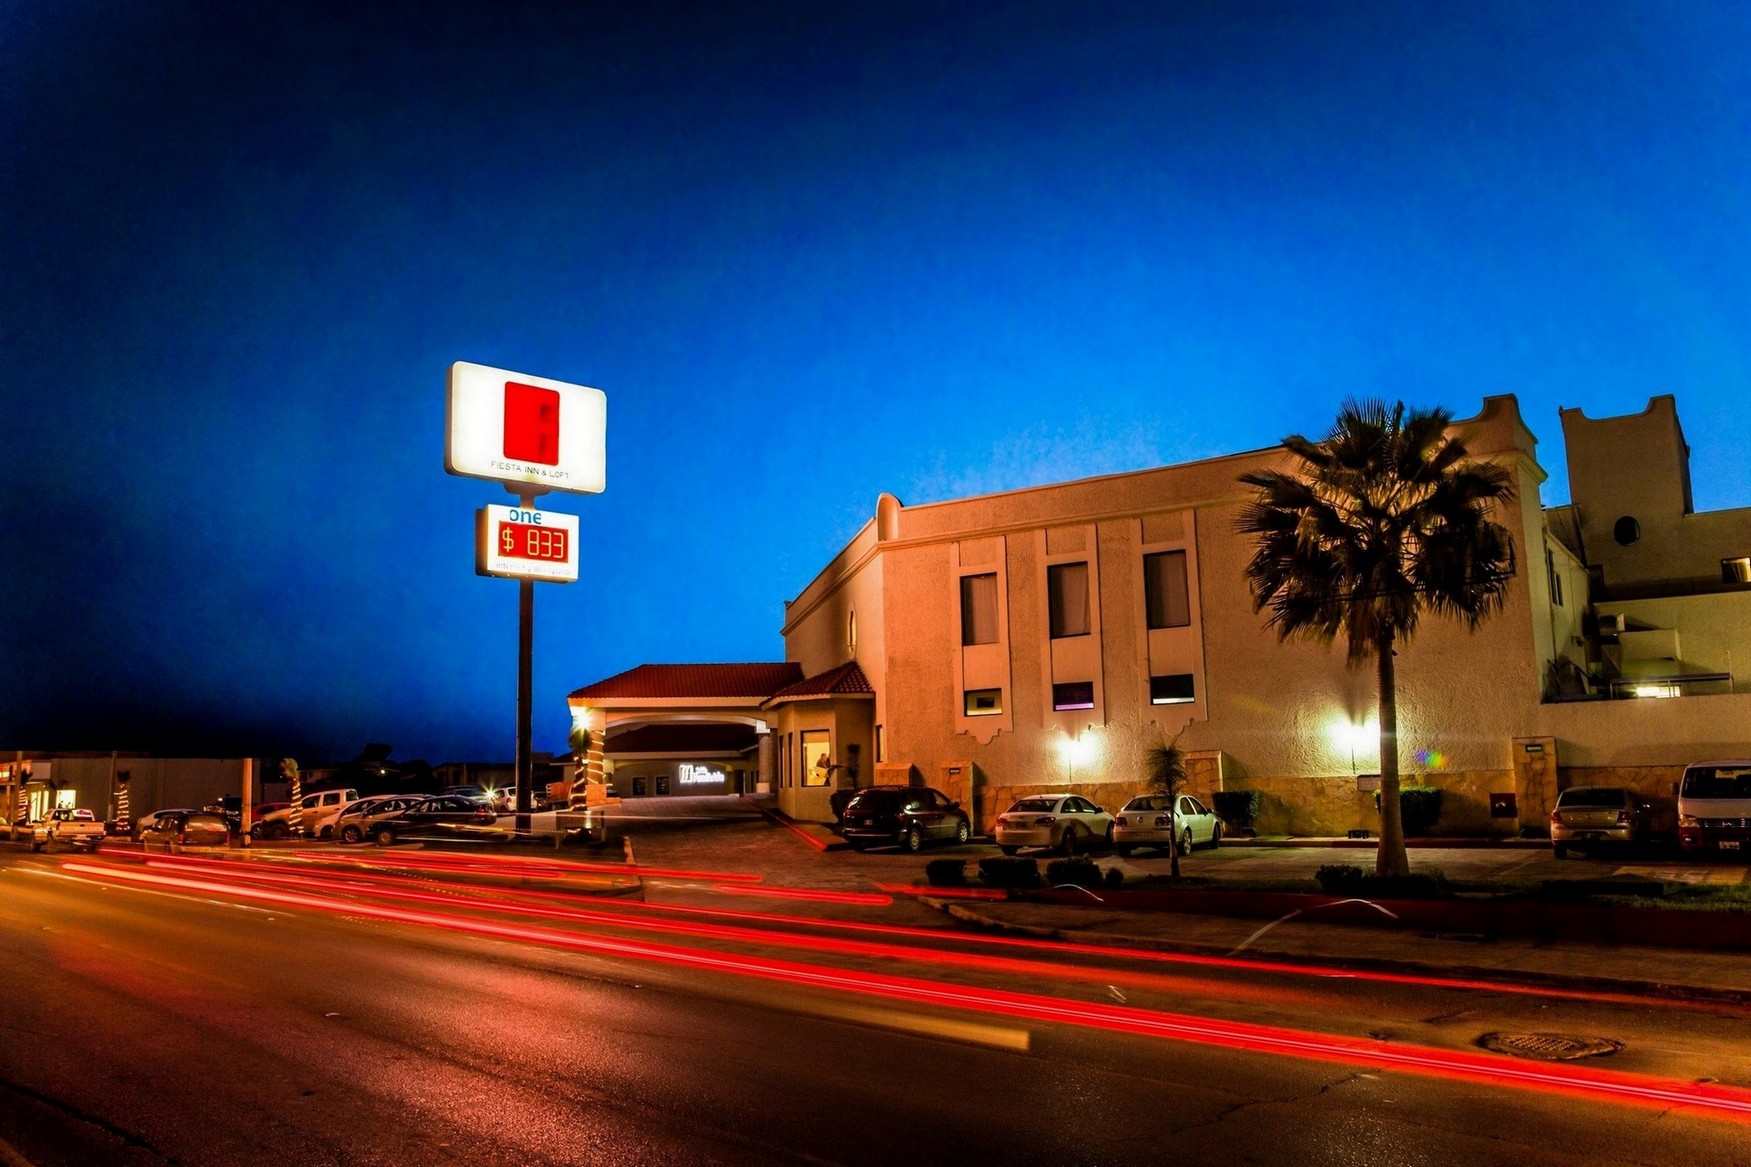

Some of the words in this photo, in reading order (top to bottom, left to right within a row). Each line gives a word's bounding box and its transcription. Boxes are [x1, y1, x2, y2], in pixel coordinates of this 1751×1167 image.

[491, 461, 522, 472] FIESTA
[525, 466, 539, 475] INN
[502, 526, 514, 553] $
[527, 529, 564, 559] 833
